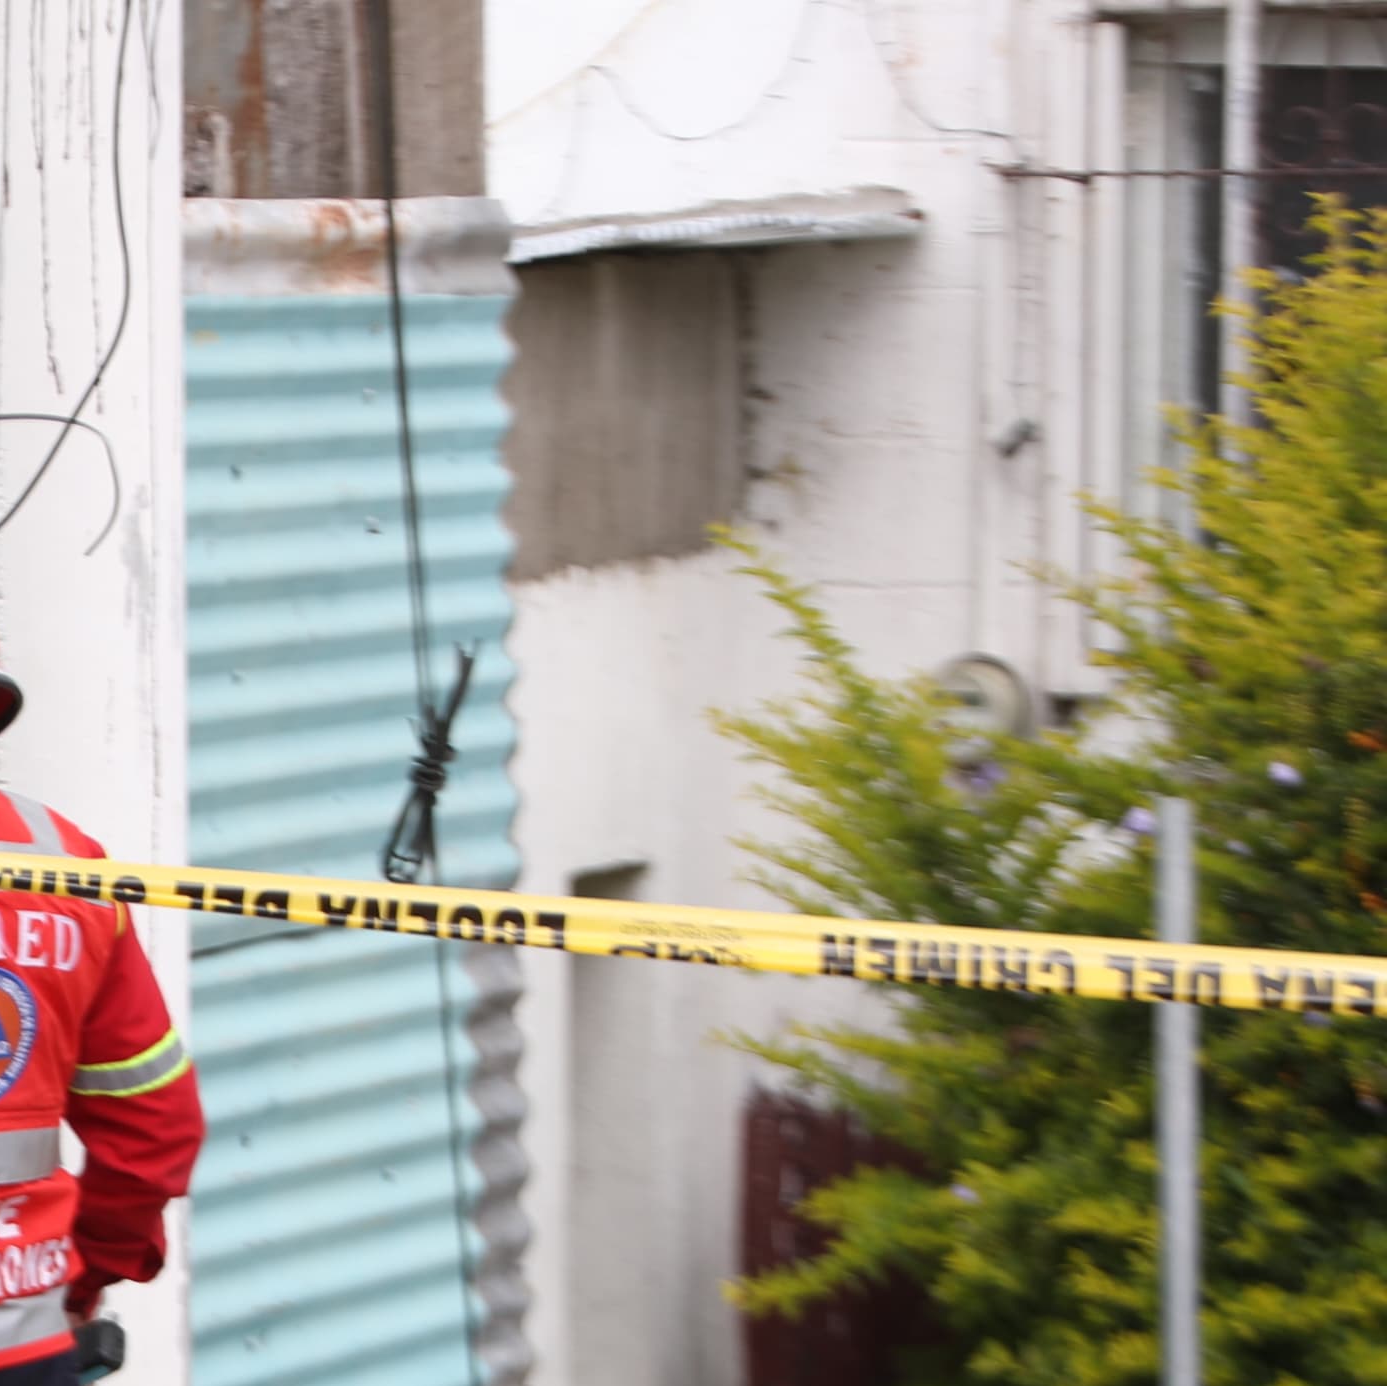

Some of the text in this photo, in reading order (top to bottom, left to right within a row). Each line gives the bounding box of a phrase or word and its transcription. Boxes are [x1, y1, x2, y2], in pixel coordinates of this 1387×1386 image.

[818, 932, 1387, 1016] ENA DEL CRIMEN
